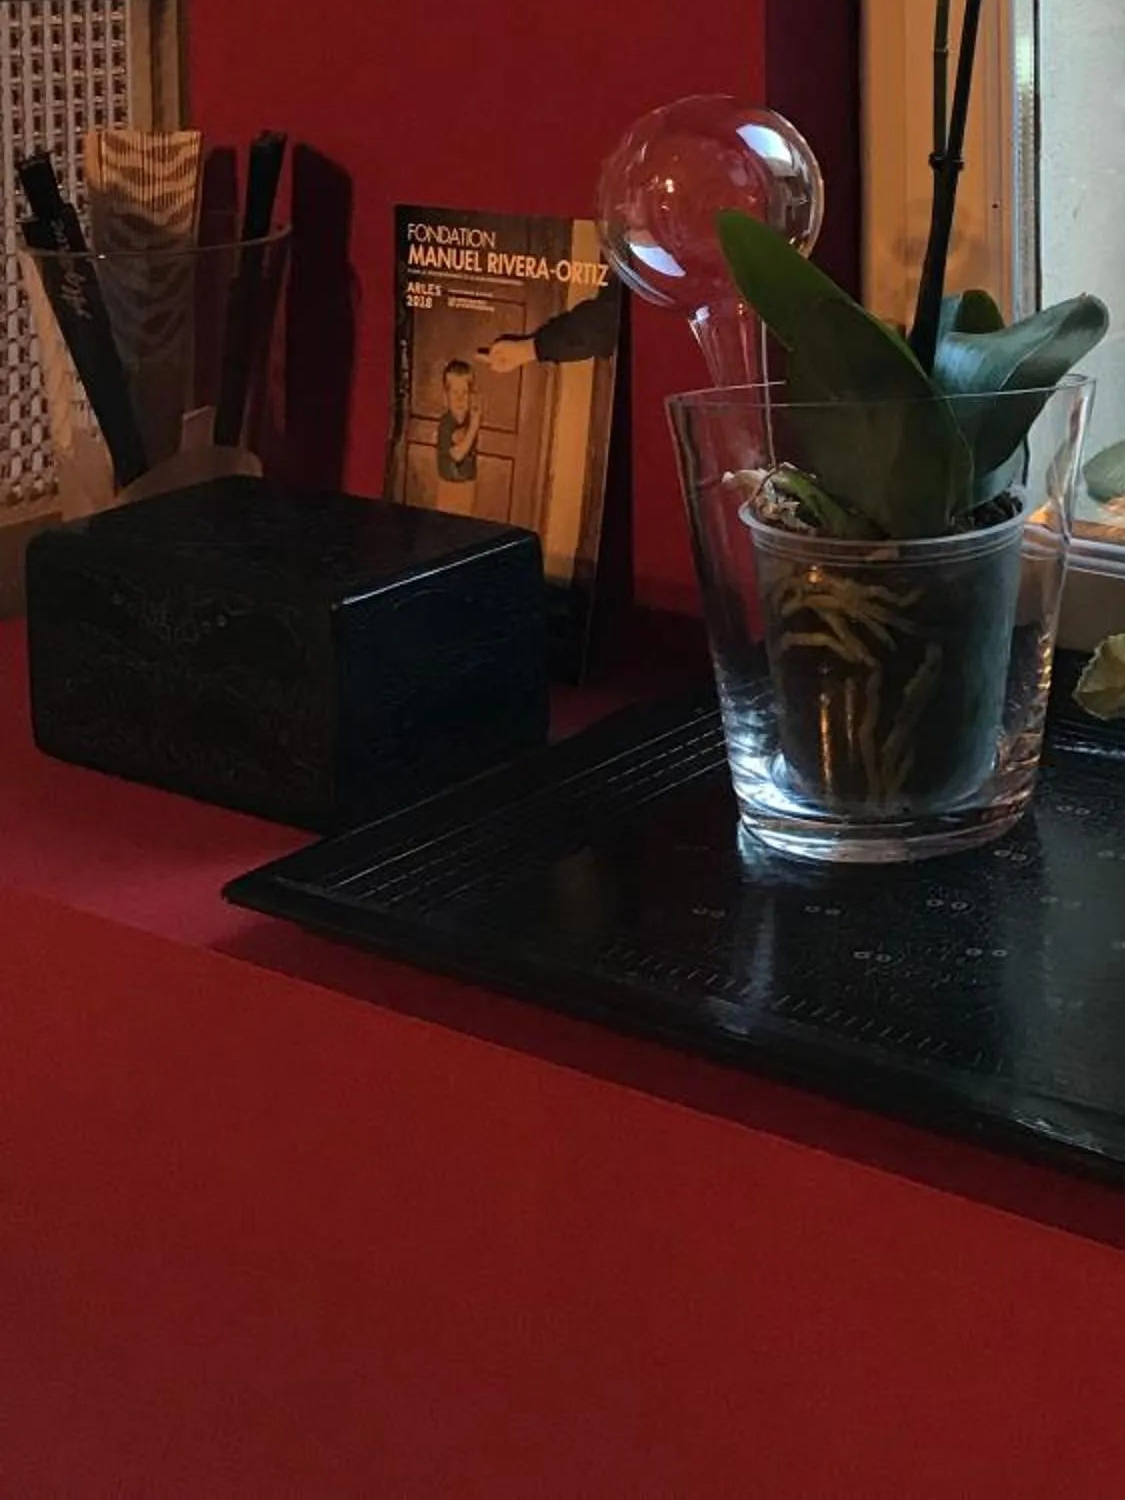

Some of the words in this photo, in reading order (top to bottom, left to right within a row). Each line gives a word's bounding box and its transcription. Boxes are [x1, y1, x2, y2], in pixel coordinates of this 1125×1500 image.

[407, 223, 497, 249] FONDATION
[408, 243, 483, 273] MANUEL
[487, 254, 609, 286] RIVERA-ORTIZ
[406, 281, 442, 297] ARLES
